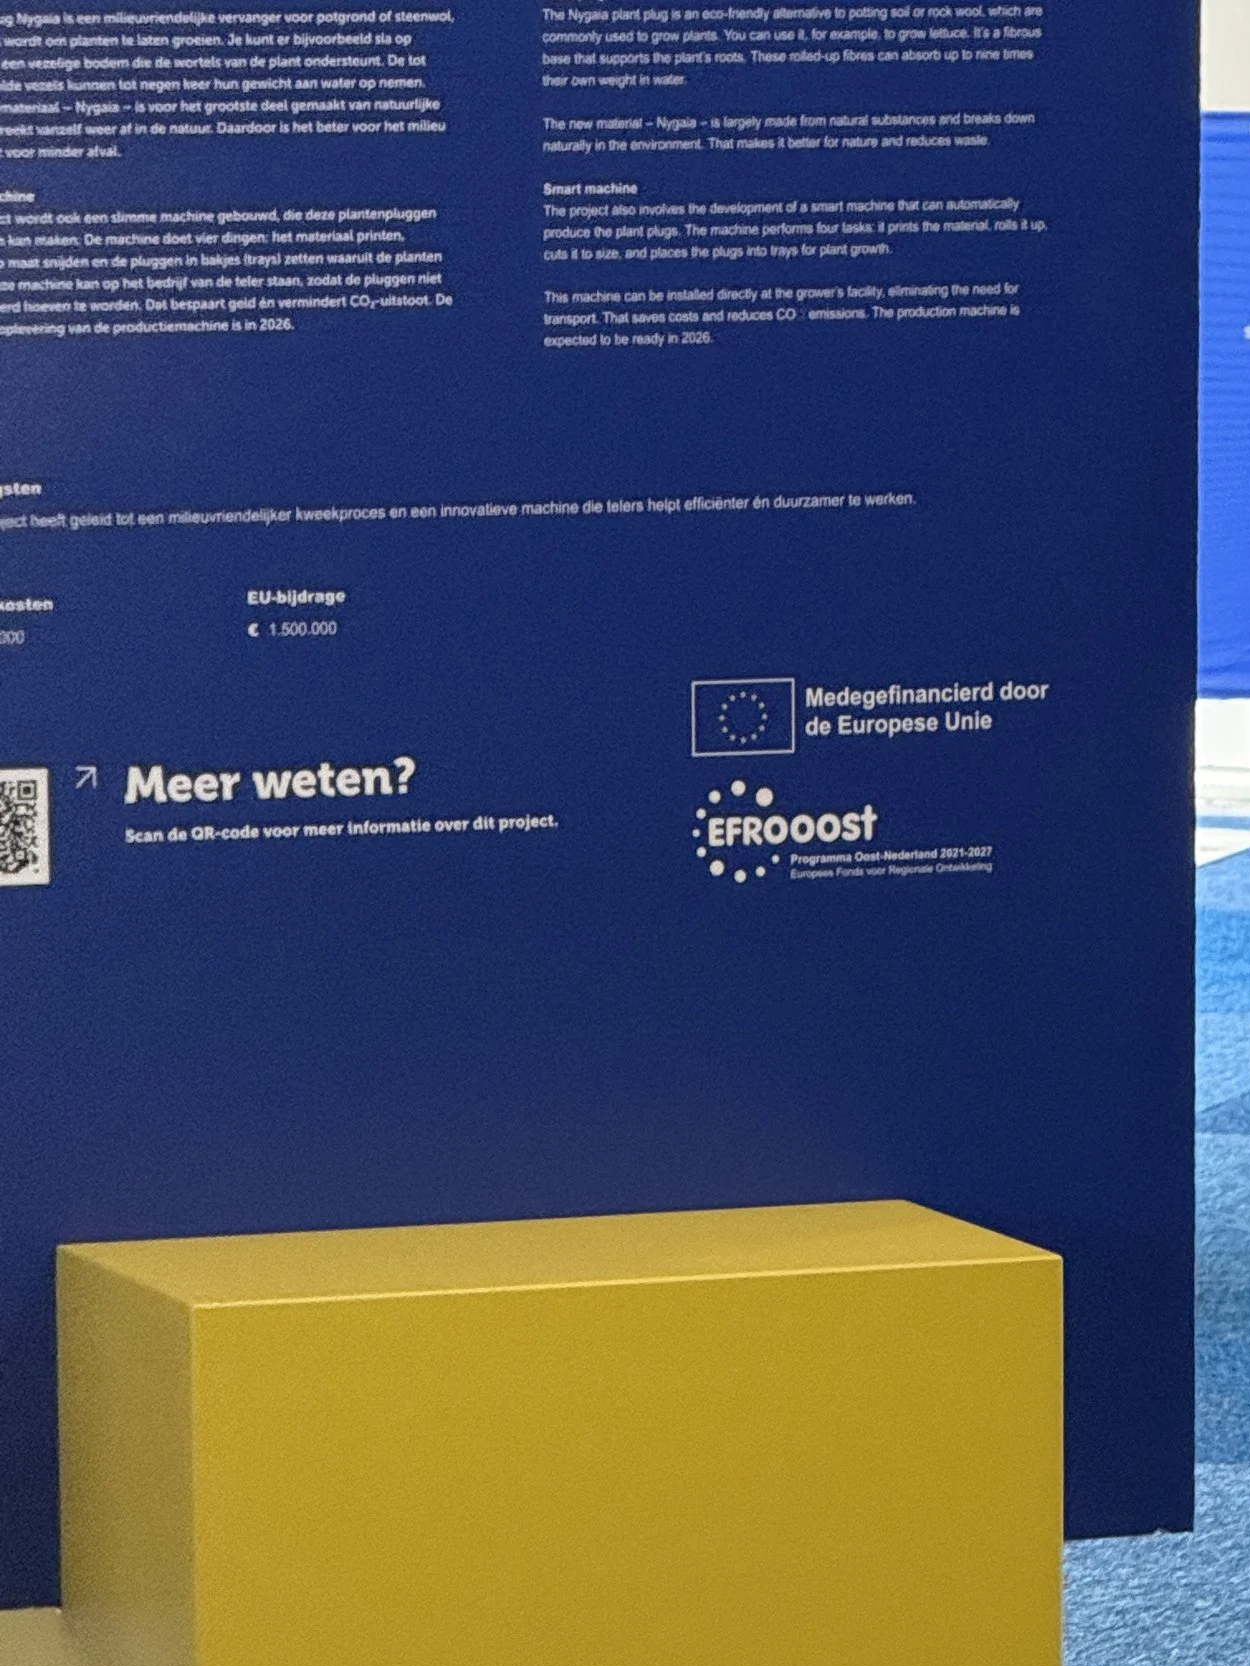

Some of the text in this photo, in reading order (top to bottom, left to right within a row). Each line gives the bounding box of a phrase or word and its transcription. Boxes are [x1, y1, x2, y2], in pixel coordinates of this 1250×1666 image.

[116, 512, 135, 526] tot
[138, 513, 164, 525] een
[296, 507, 386, 522] kweekproces
[389, 507, 407, 518] en
[411, 506, 437, 518] een
[441, 503, 517, 517] innovatieve
[522, 501, 579, 515] machine
[582, 500, 603, 513] die
[607, 499, 644, 513] telers
[648, 499, 680, 513] helpt
[753, 496, 770, 509] én
[774, 495, 845, 508] duurzamer
[848, 495, 861, 506] te
[248, 590, 345, 606] EU-bijdrage
[270, 621, 337, 636] 1.500.000
[806, 681, 1049, 710] Medegefinancierd door
[805, 711, 992, 738] de Europese Unie
[125, 756, 415, 804] Meer weten?
[126, 814, 558, 843] Scan de QR-code voor meer informatie over dit project.
[791, 846, 992, 866] Programma Oost-Nederland 2021-2027
[836, 867, 864, 877] Fonds
[866, 867, 886, 876] voor
